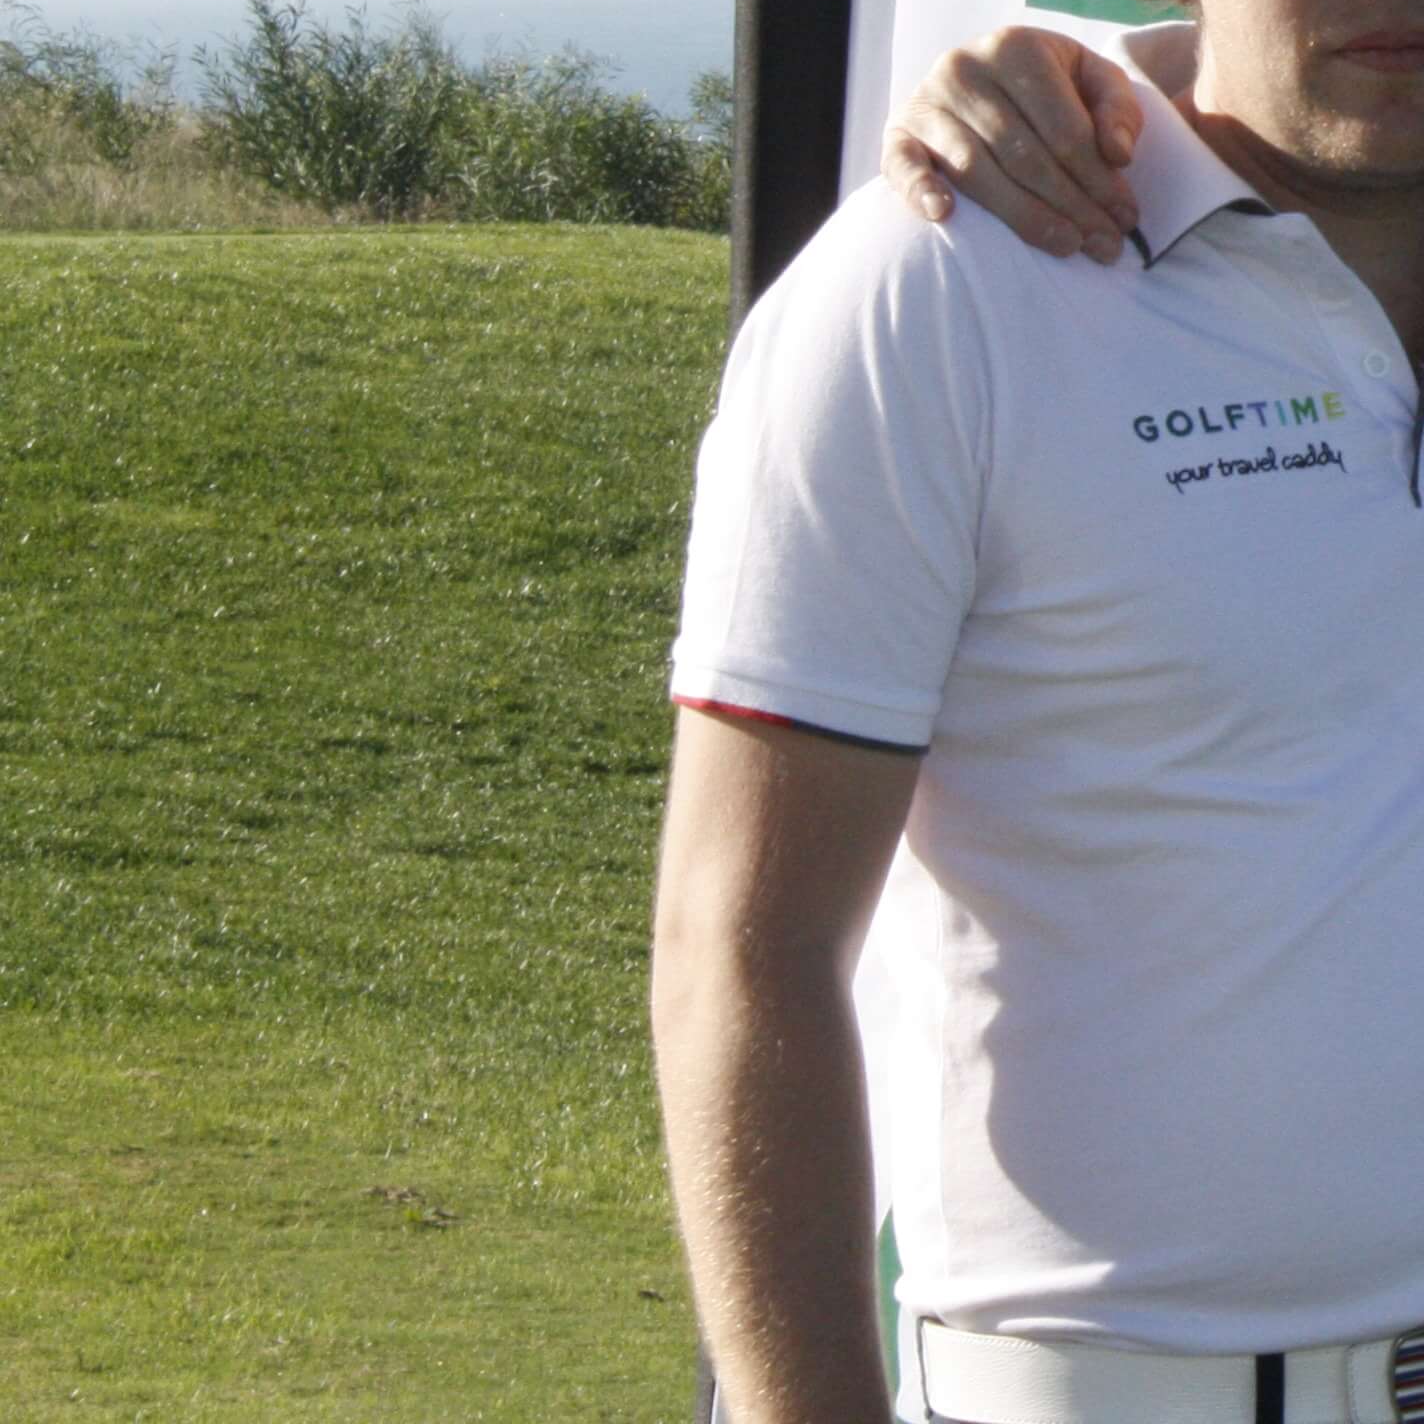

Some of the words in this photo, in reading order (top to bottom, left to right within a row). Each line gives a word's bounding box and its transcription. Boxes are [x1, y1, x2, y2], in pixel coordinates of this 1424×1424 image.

[1133, 391, 1346, 443] GOLFTIME
[1165, 462, 1213, 495] your
[1217, 445, 1278, 477] travel
[1280, 440, 1348, 474] caddy
